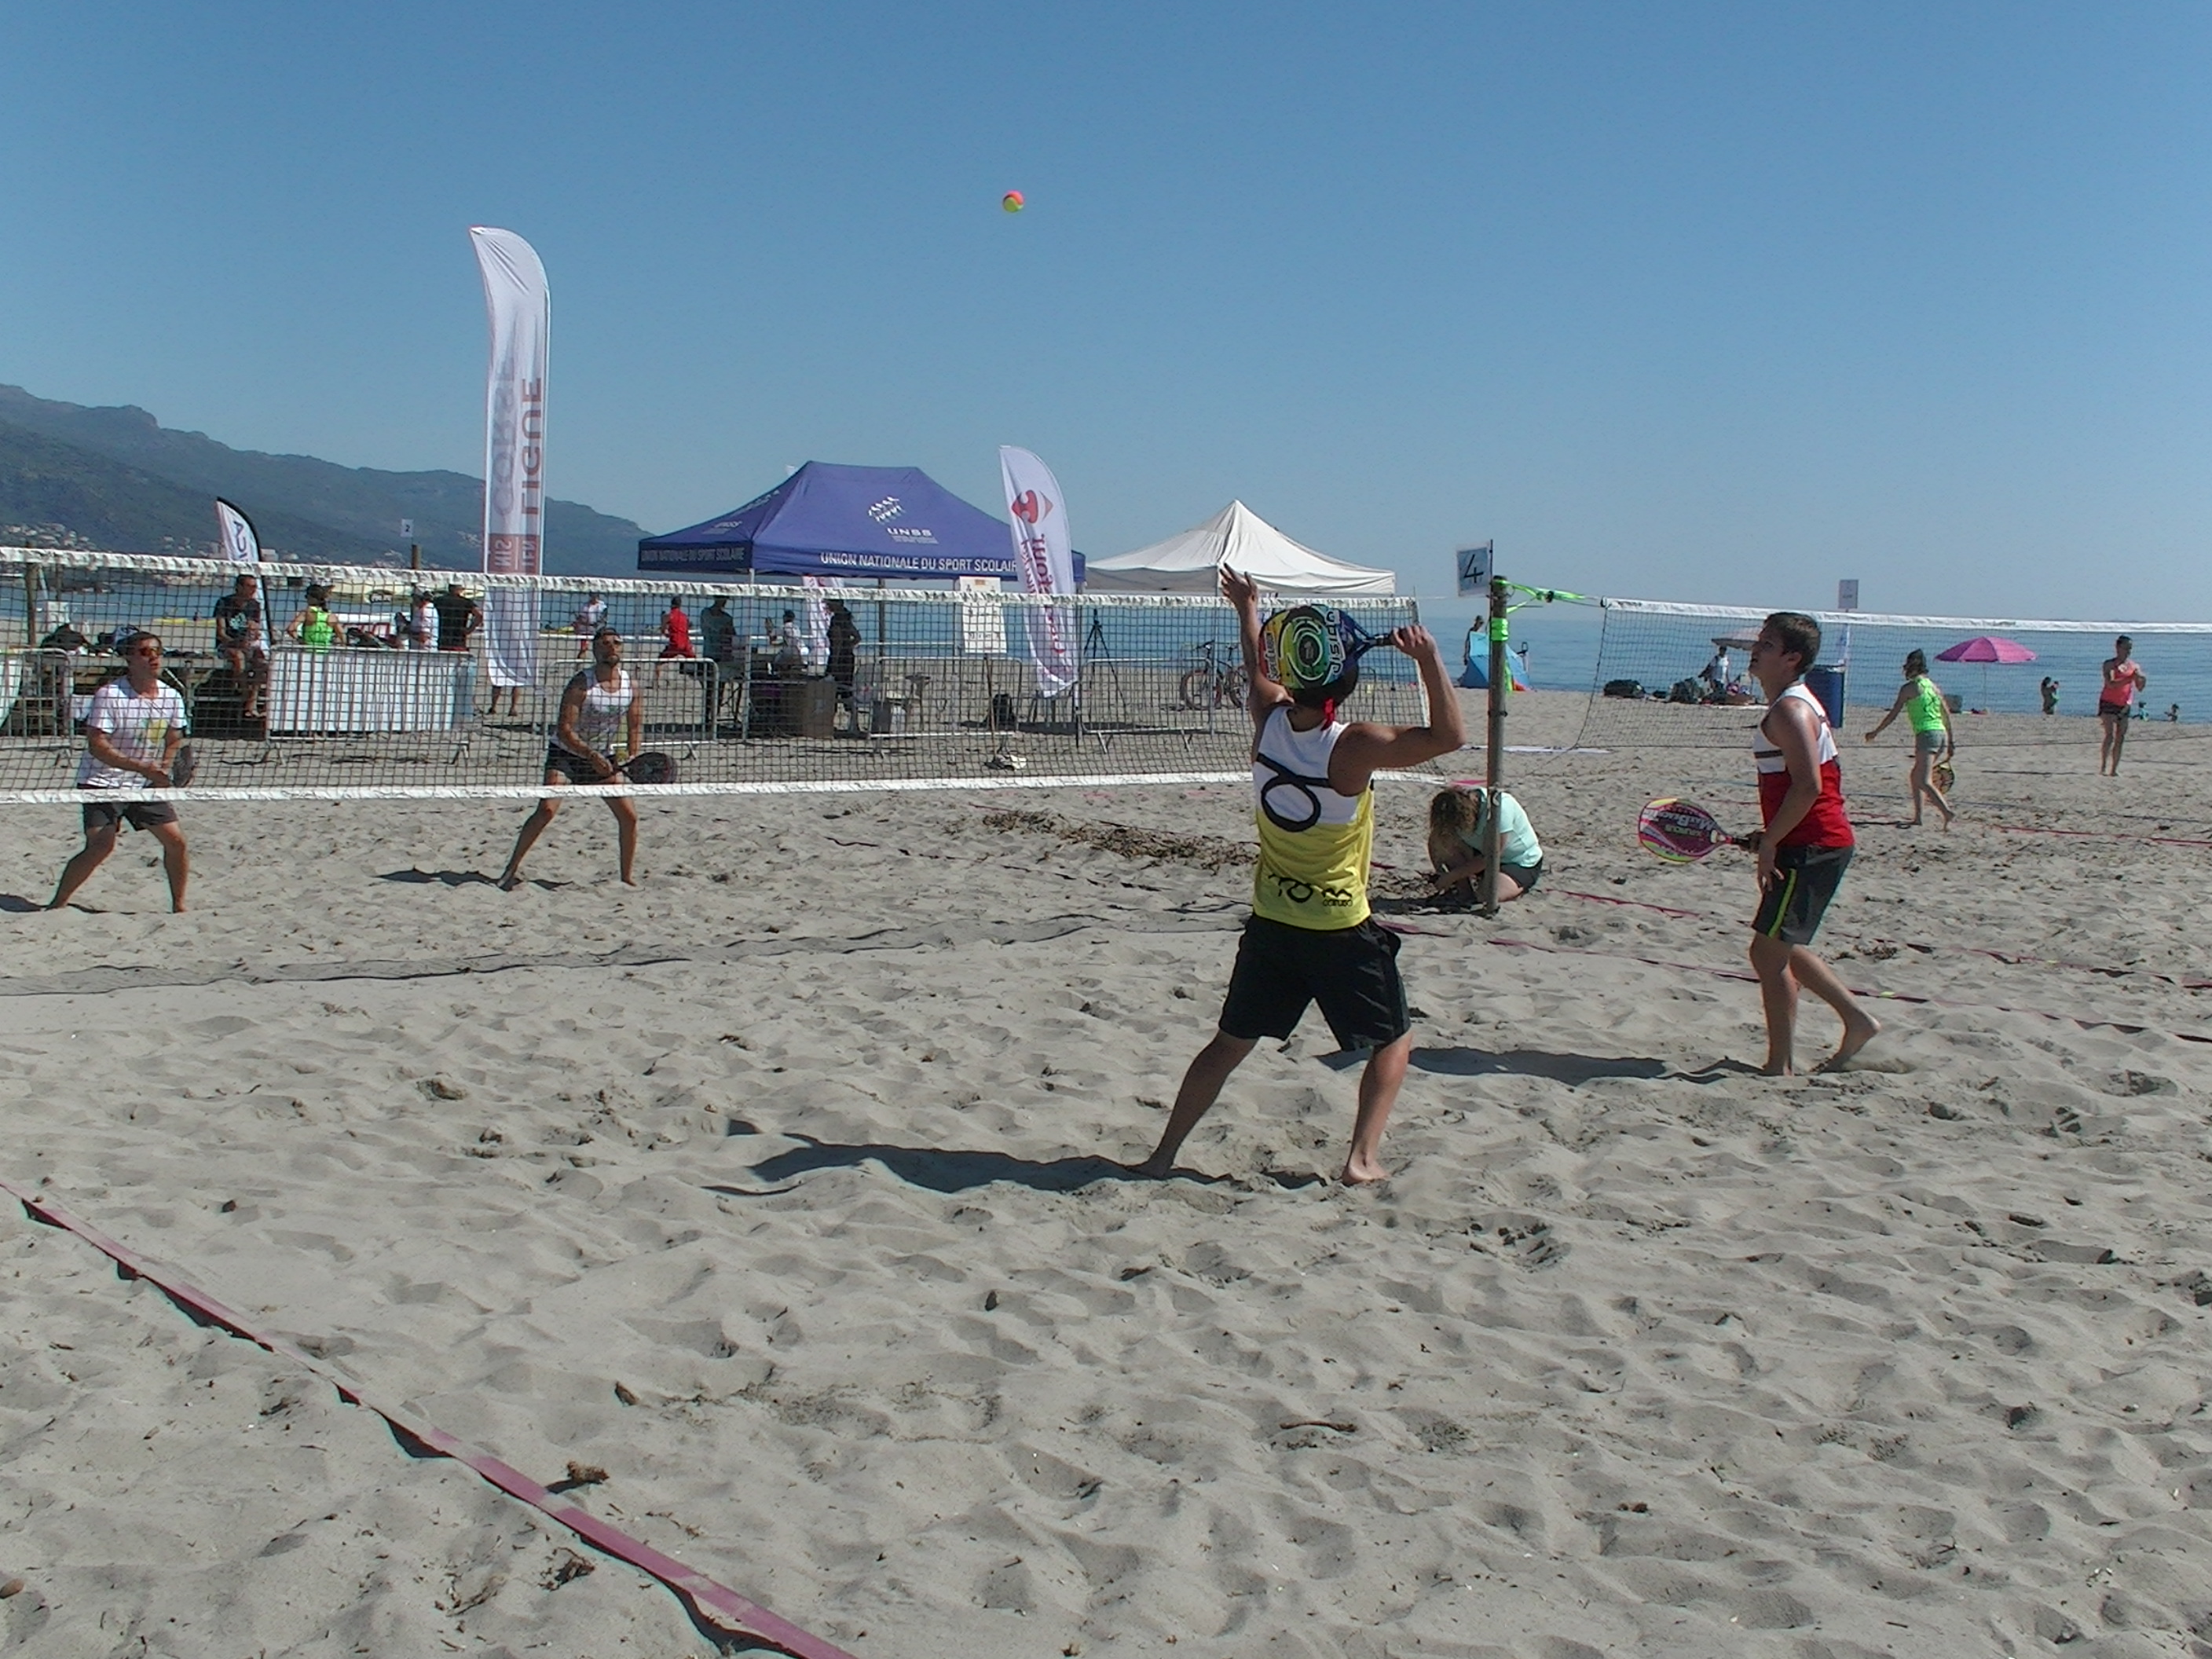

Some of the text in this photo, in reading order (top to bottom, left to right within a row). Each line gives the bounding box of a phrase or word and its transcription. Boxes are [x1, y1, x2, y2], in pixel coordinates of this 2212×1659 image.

[820, 551, 1017, 573] UNION NATIONALE DU SPORT SCOLAIR
[1463, 554, 1485, 584] 4
